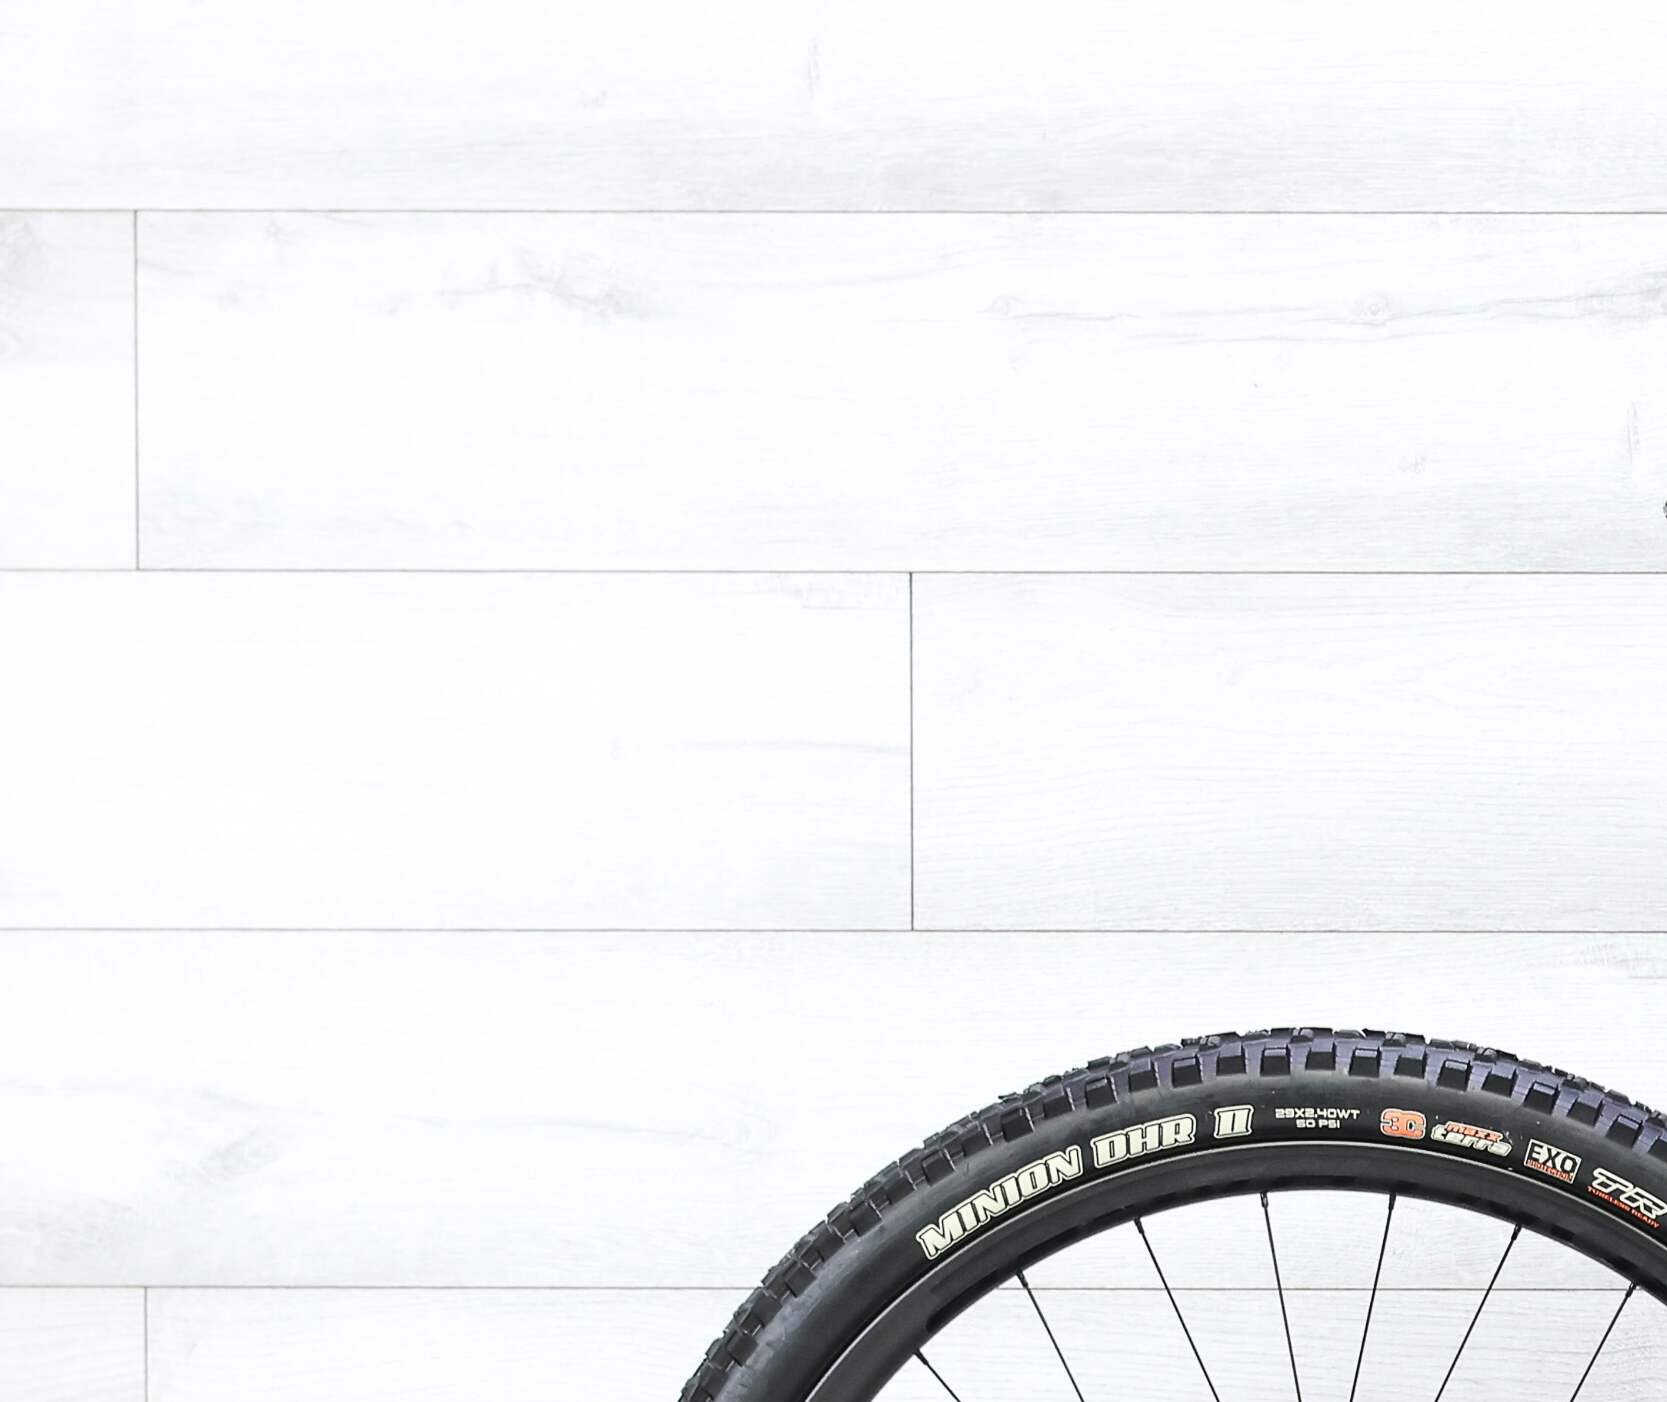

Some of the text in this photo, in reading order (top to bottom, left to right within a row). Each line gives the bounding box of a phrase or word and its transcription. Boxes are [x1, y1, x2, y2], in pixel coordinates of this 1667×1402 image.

[1275, 1107, 1360, 1120] 29X2.40WT
[1318, 1119, 1341, 1129] PSI
[1379, 1108, 1427, 1140] 3C
[1526, 1141, 1578, 1174] EXO
[915, 1145, 1084, 1261] MINION
[1090, 1113, 1197, 1169] DHR
